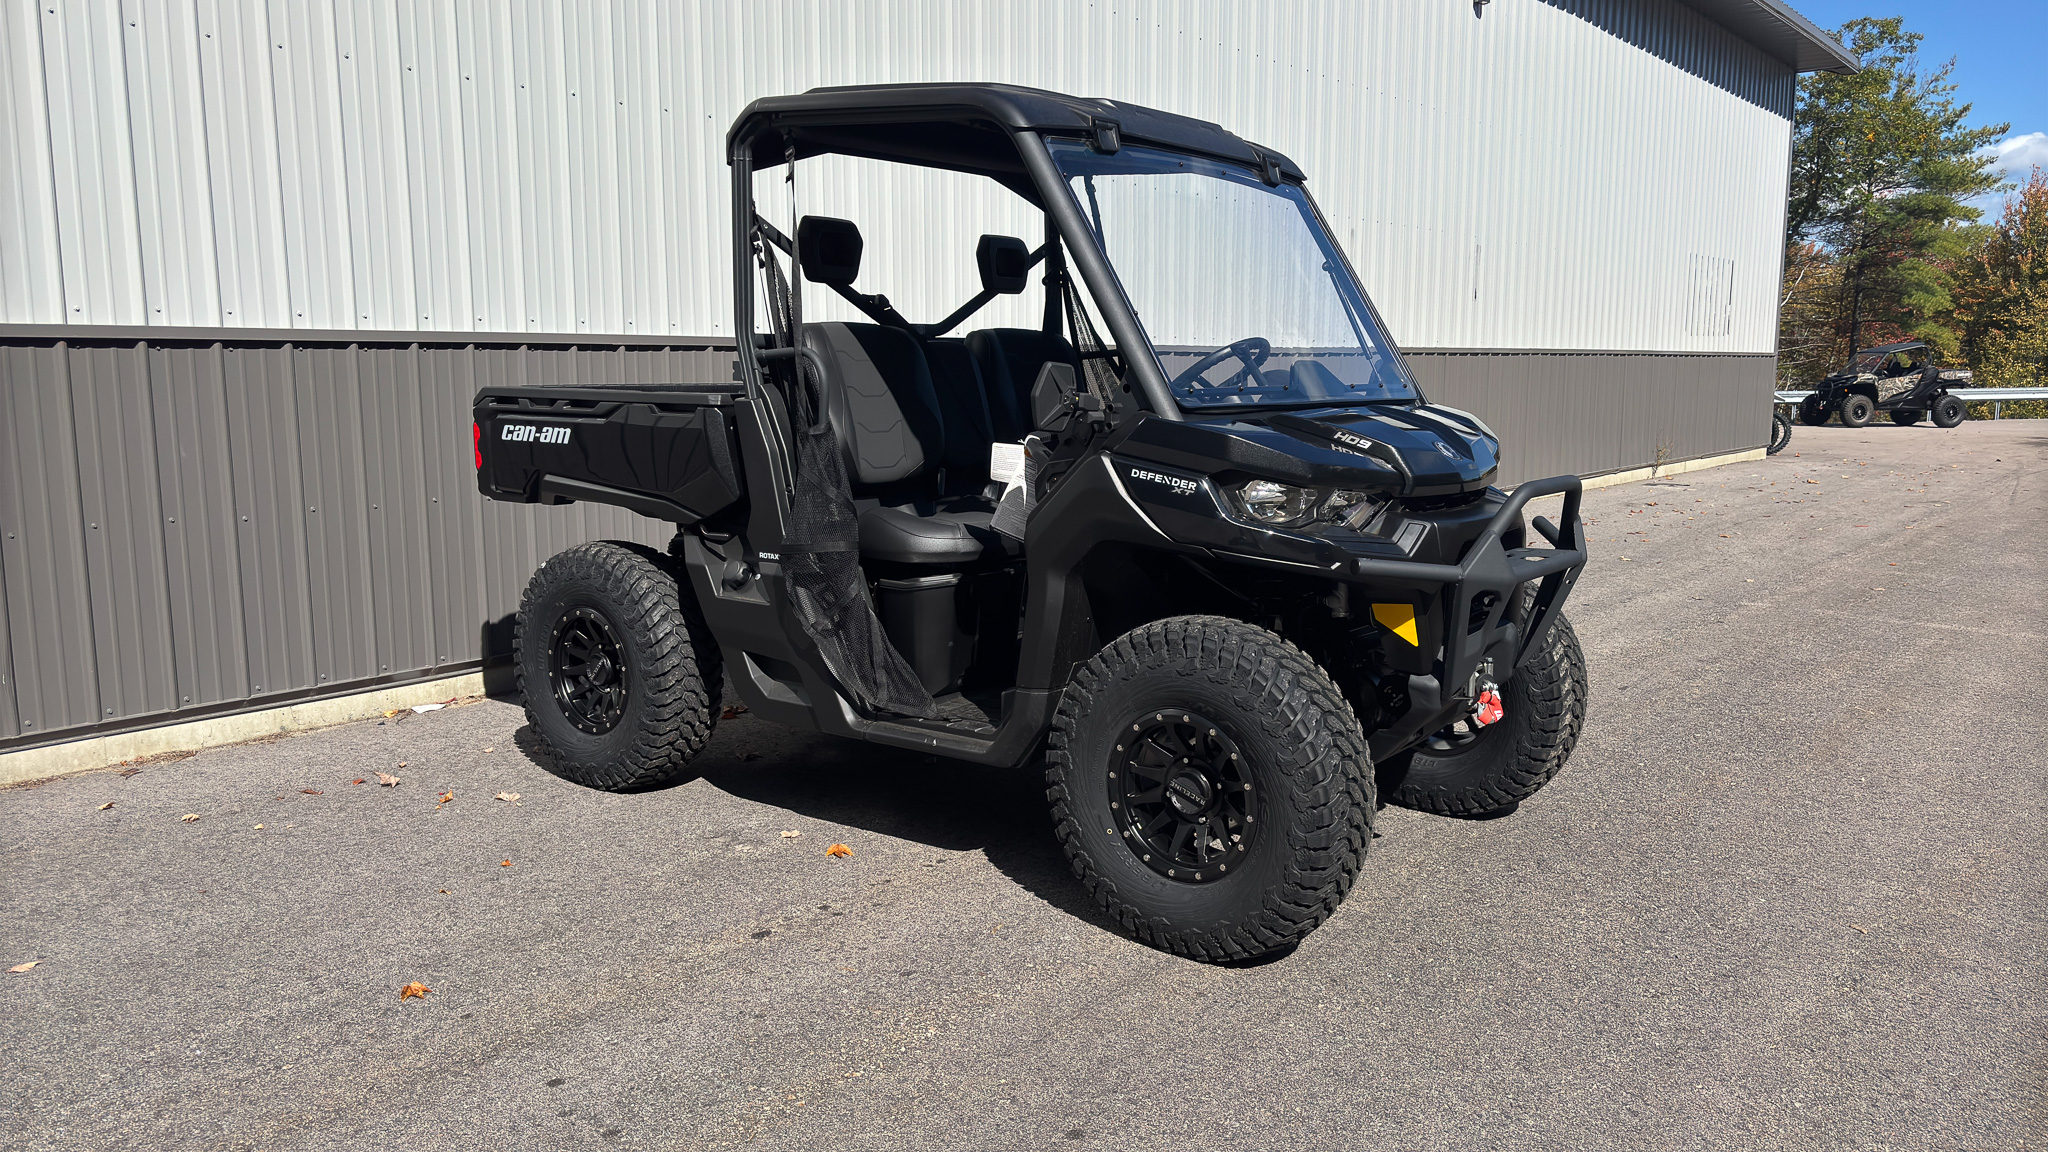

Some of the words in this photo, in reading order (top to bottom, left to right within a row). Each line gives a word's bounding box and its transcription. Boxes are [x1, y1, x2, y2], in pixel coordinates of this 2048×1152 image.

[501, 424, 572, 444] can-am
[1333, 431, 1373, 450] HD9
[1130, 468, 1197, 491] DEFENDER
[1170, 486, 1196, 497] XT
[758, 551, 780, 560] ROTAX
[1168, 780, 1207, 806] RACELINE
